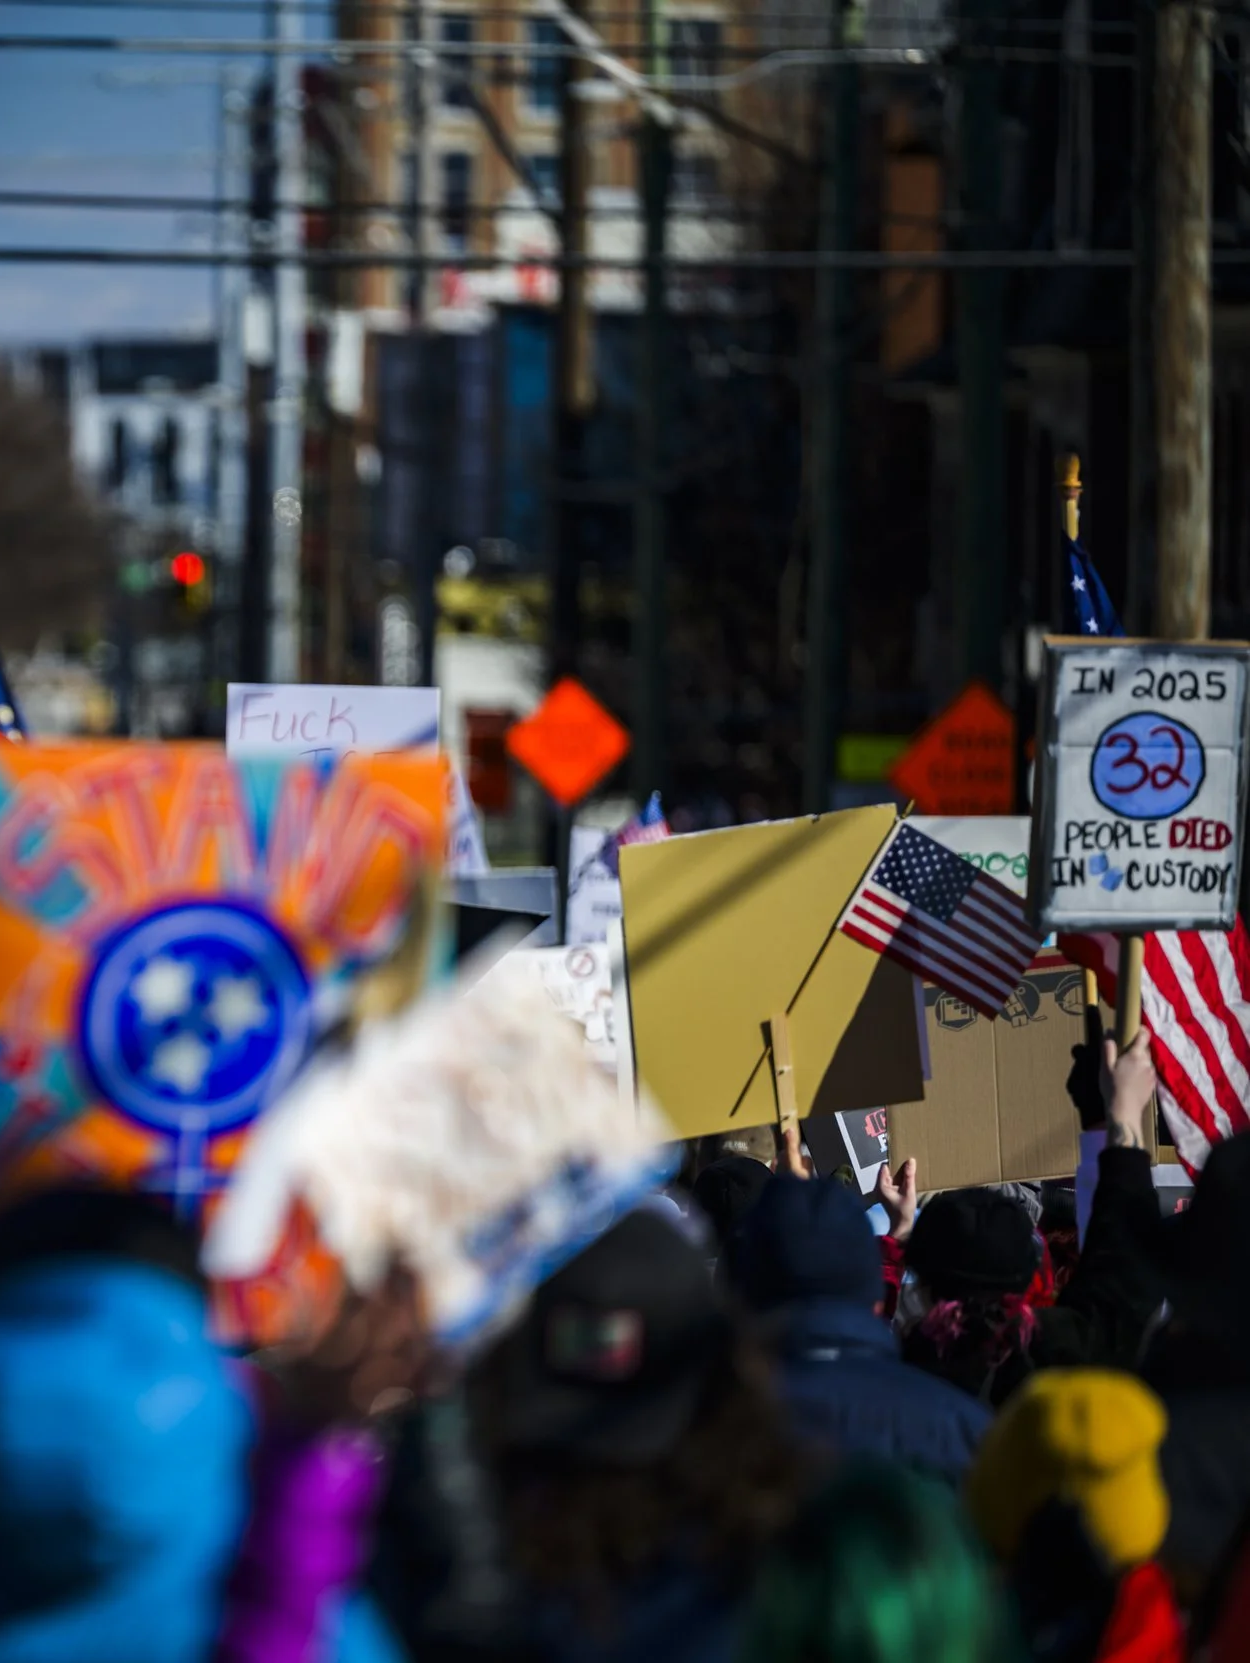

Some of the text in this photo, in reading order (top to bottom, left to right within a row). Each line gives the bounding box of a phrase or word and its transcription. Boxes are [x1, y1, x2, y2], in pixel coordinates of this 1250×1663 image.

[1071, 667, 1227, 701] IN 2025
[1105, 726, 1191, 795] 32
[1065, 818, 1233, 854] PEOPLE DIED
[1051, 857, 1233, 894] IN CUSTODY
